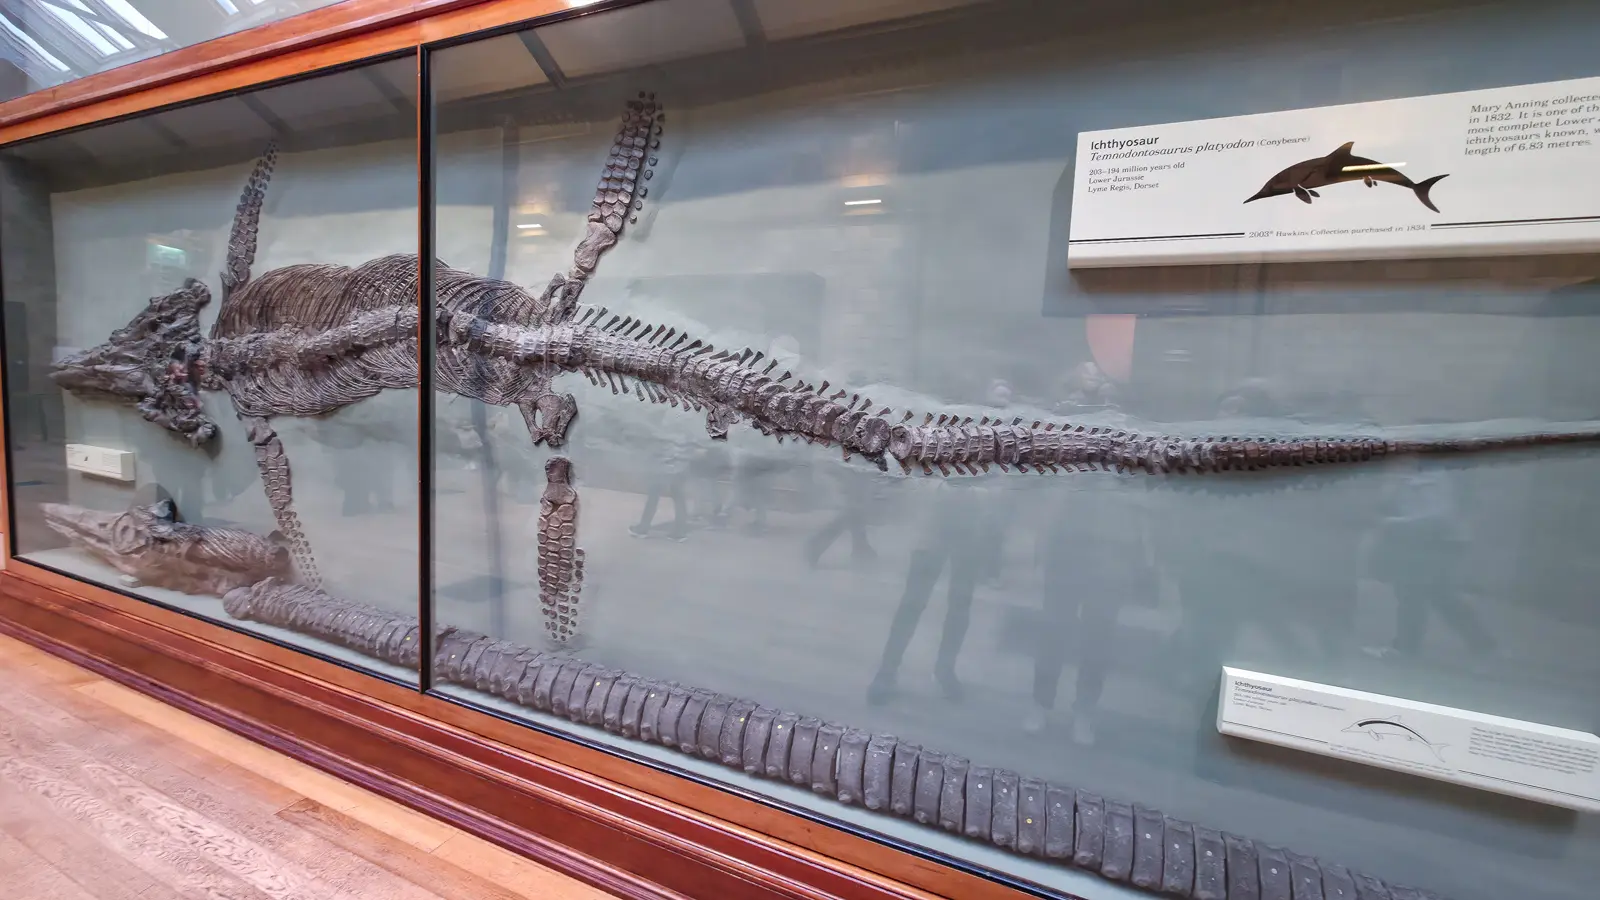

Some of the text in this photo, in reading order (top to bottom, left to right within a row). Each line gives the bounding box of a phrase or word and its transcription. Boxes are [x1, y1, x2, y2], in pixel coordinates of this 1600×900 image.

[1470, 94, 1600, 114] Mary Anning collecte
[1484, 112, 1514, 122] 1832.
[1518, 111, 1528, 120] It
[1532, 109, 1542, 118] is
[1546, 108, 1568, 116] one
[1570, 104, 1584, 113] of
[1586, 104, 1600, 112] th
[1468, 126, 1495, 134] most
[1498, 120, 1552, 132] complete
[1556, 116, 1596, 126] Lower
[1090, 136, 1160, 150] Ichthyosaur
[1466, 133, 1540, 145] ichthyosaurs
[1090, 136, 1310, 161] Temnodontosaurus platyodon (Conybeare)
[1464, 144, 1500, 156] length
[1504, 144, 1518, 152] of
[1518, 141, 1544, 151] 6.83
[1122, 165, 1148, 173] million
[1150, 164, 1172, 172] years
[1134, 182, 1160, 190] Dorset
[1350, 226, 1393, 236] purchased
